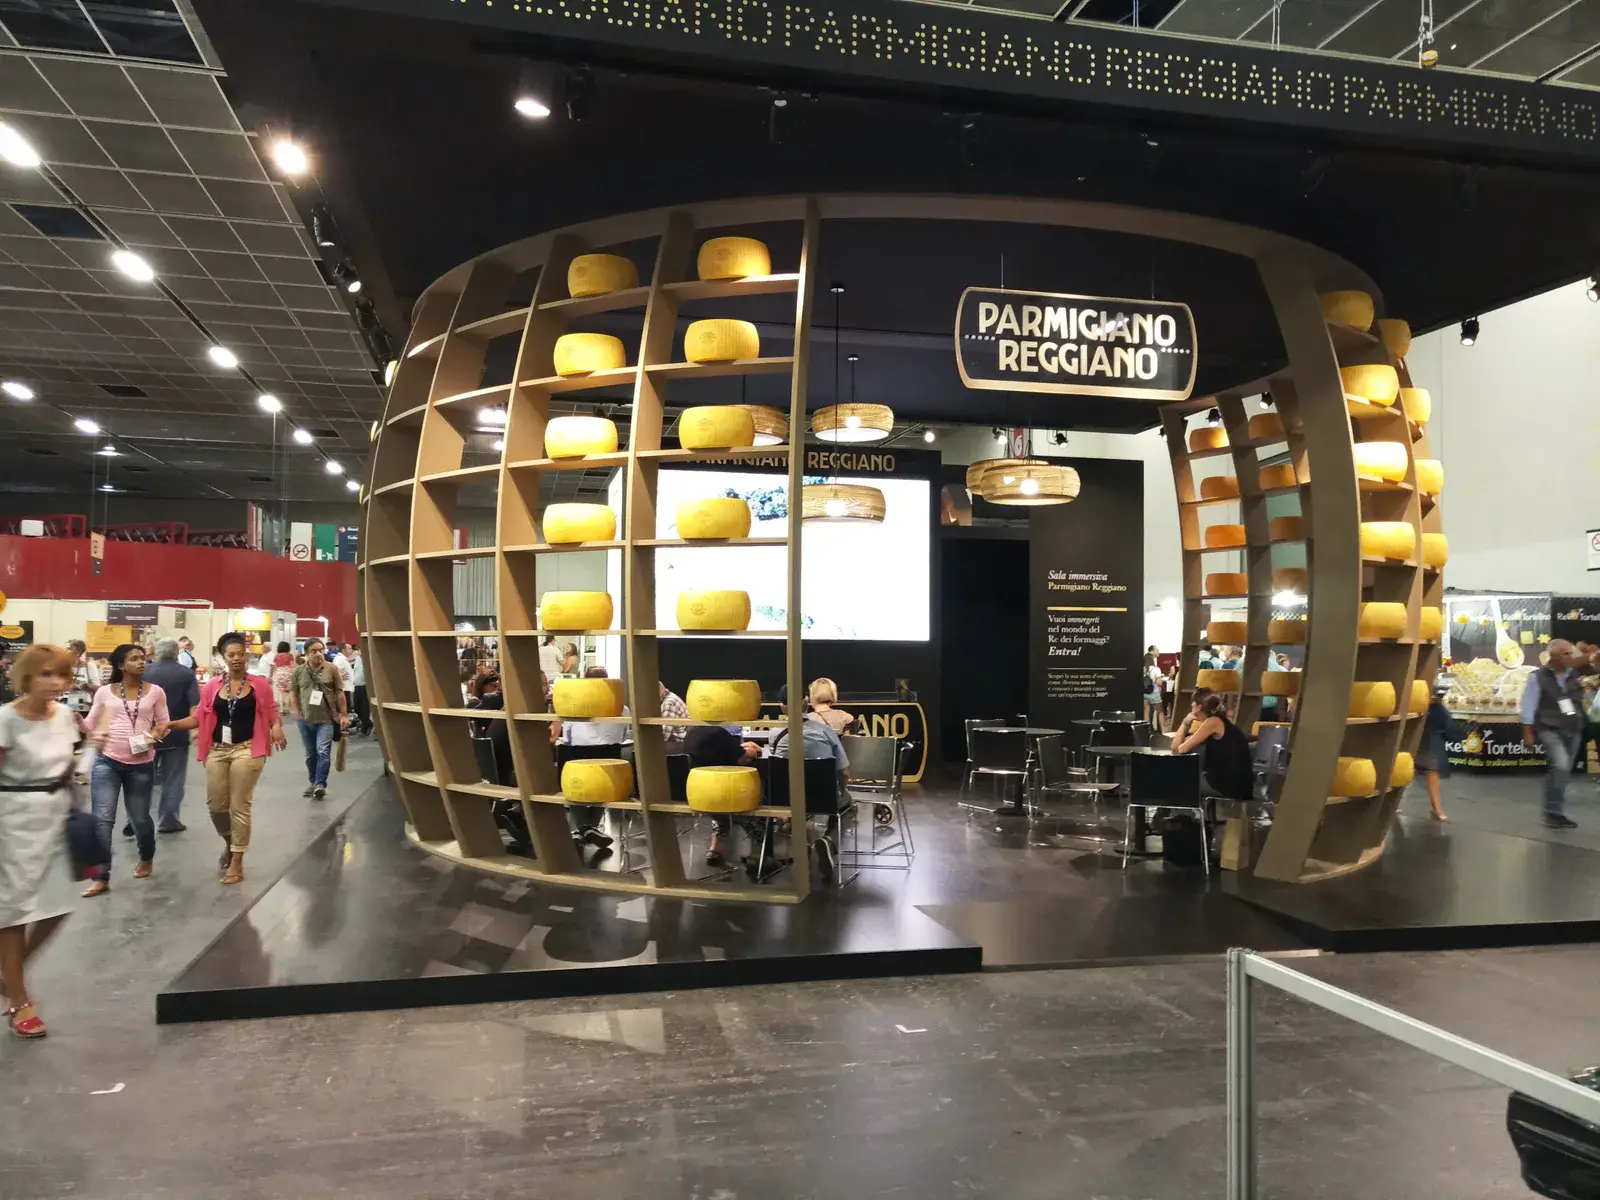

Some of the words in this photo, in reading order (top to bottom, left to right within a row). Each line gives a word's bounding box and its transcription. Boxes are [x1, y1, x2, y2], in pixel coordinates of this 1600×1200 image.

[978, 301, 1177, 347] PARMIGIANO
[999, 339, 1159, 380] REGGIANO
[807, 451, 896, 472] REGGIANO
[1048, 570, 1066, 581] Sala
[1068, 571, 1108, 581] immersiva
[1048, 582, 1091, 592] Parmigiano
[1092, 583, 1127, 593] Reggiano
[1048, 615, 1066, 623] Vuoi
[1048, 625, 1060, 633] nel
[1060, 635, 1072, 643] dei
[1048, 646, 1082, 656] Entra!
